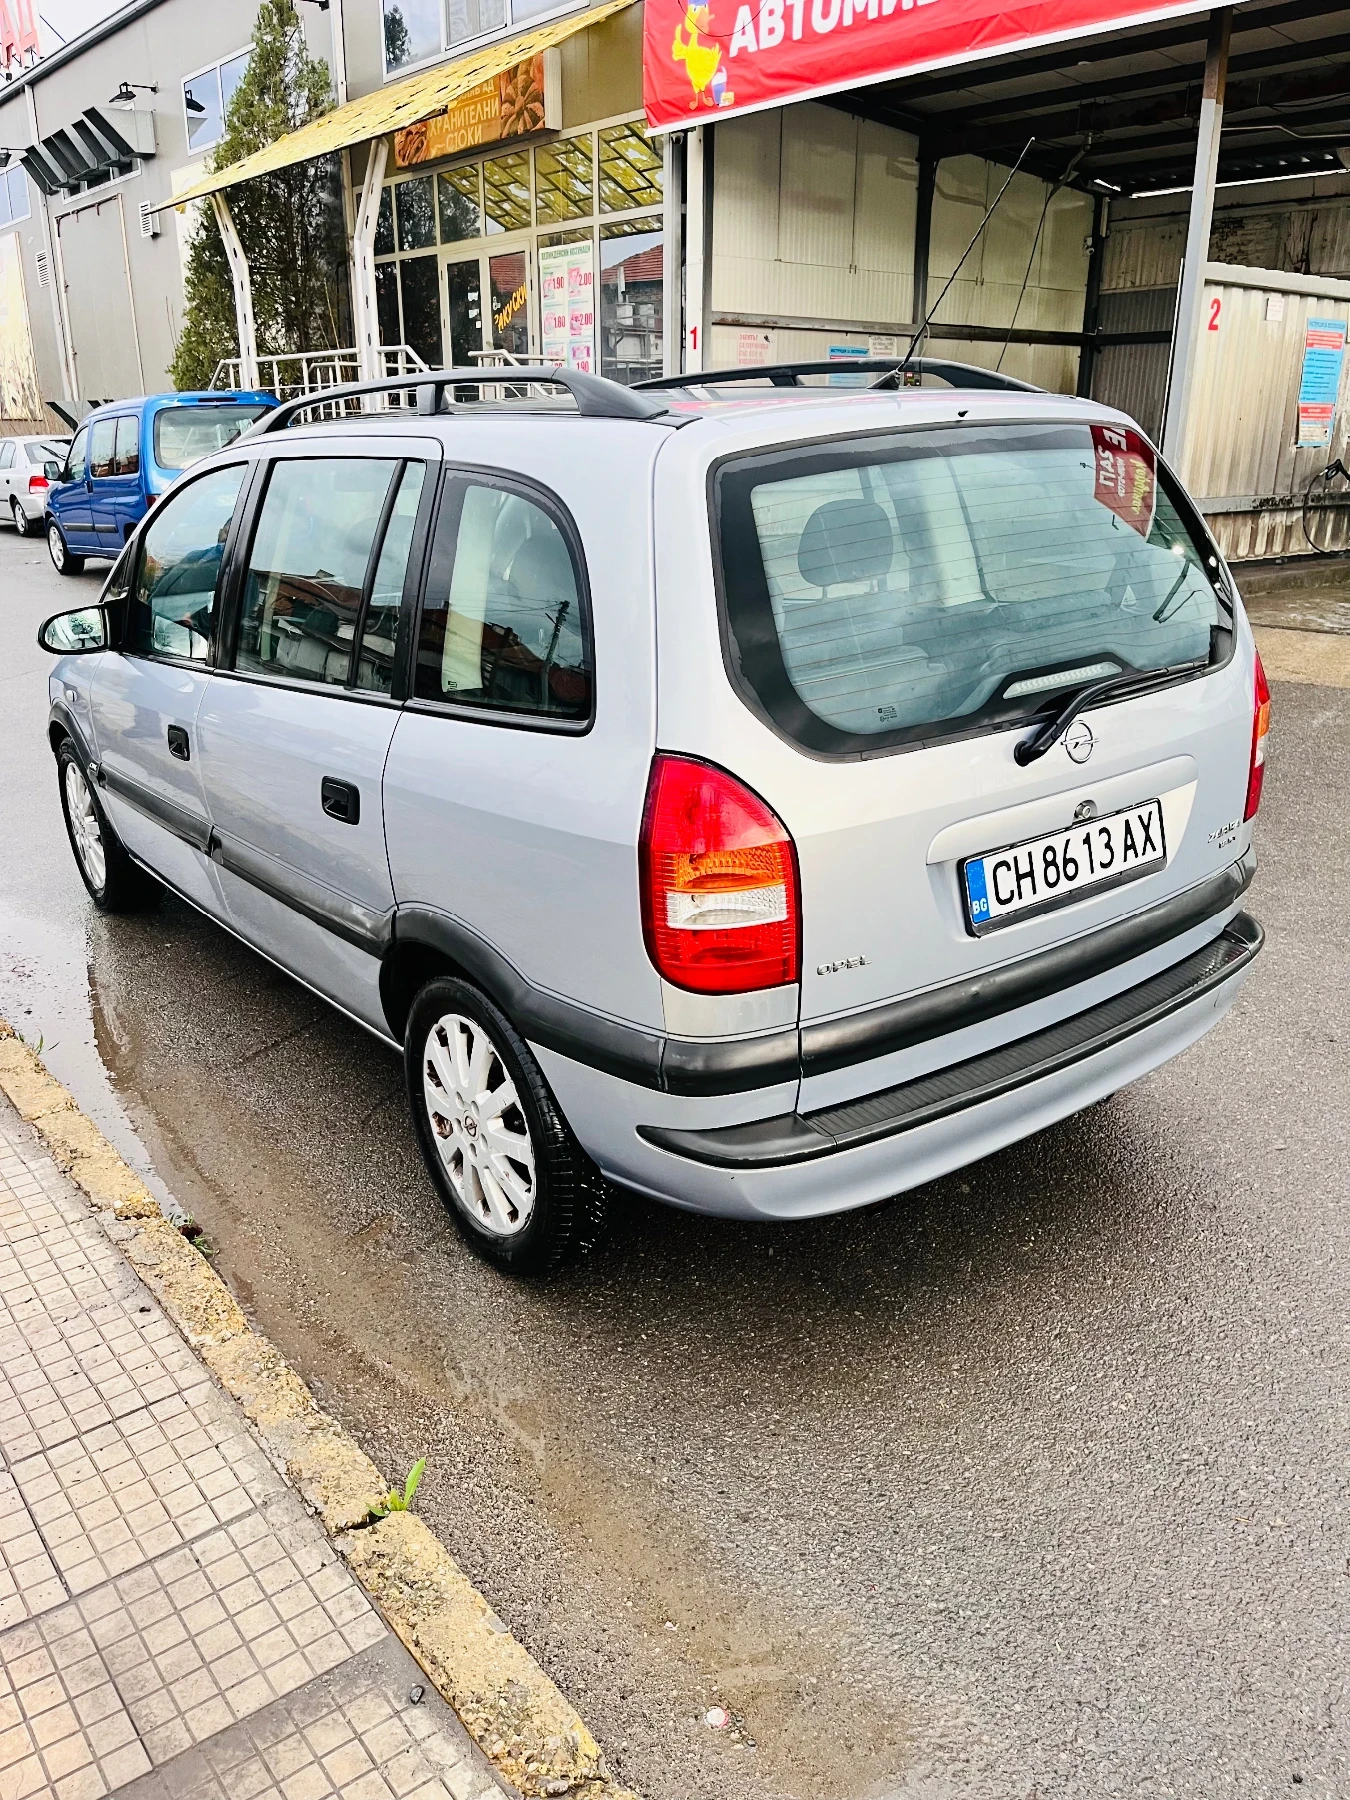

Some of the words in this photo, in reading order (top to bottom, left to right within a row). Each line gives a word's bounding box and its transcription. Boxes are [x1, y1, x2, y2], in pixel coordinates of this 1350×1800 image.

[428, 97, 500, 137] ХРАНИТЕЛНИ
[446, 124, 482, 151] СТОКИ
[552, 276, 565, 290] 1.90
[578, 272, 592, 286] 2.00
[579, 312, 593, 326] 2.00
[1208, 298, 1221, 331] 2
[689, 326, 698, 350] 1
[971, 897, 988, 915] BG
[816, 954, 873, 977] OPEL
